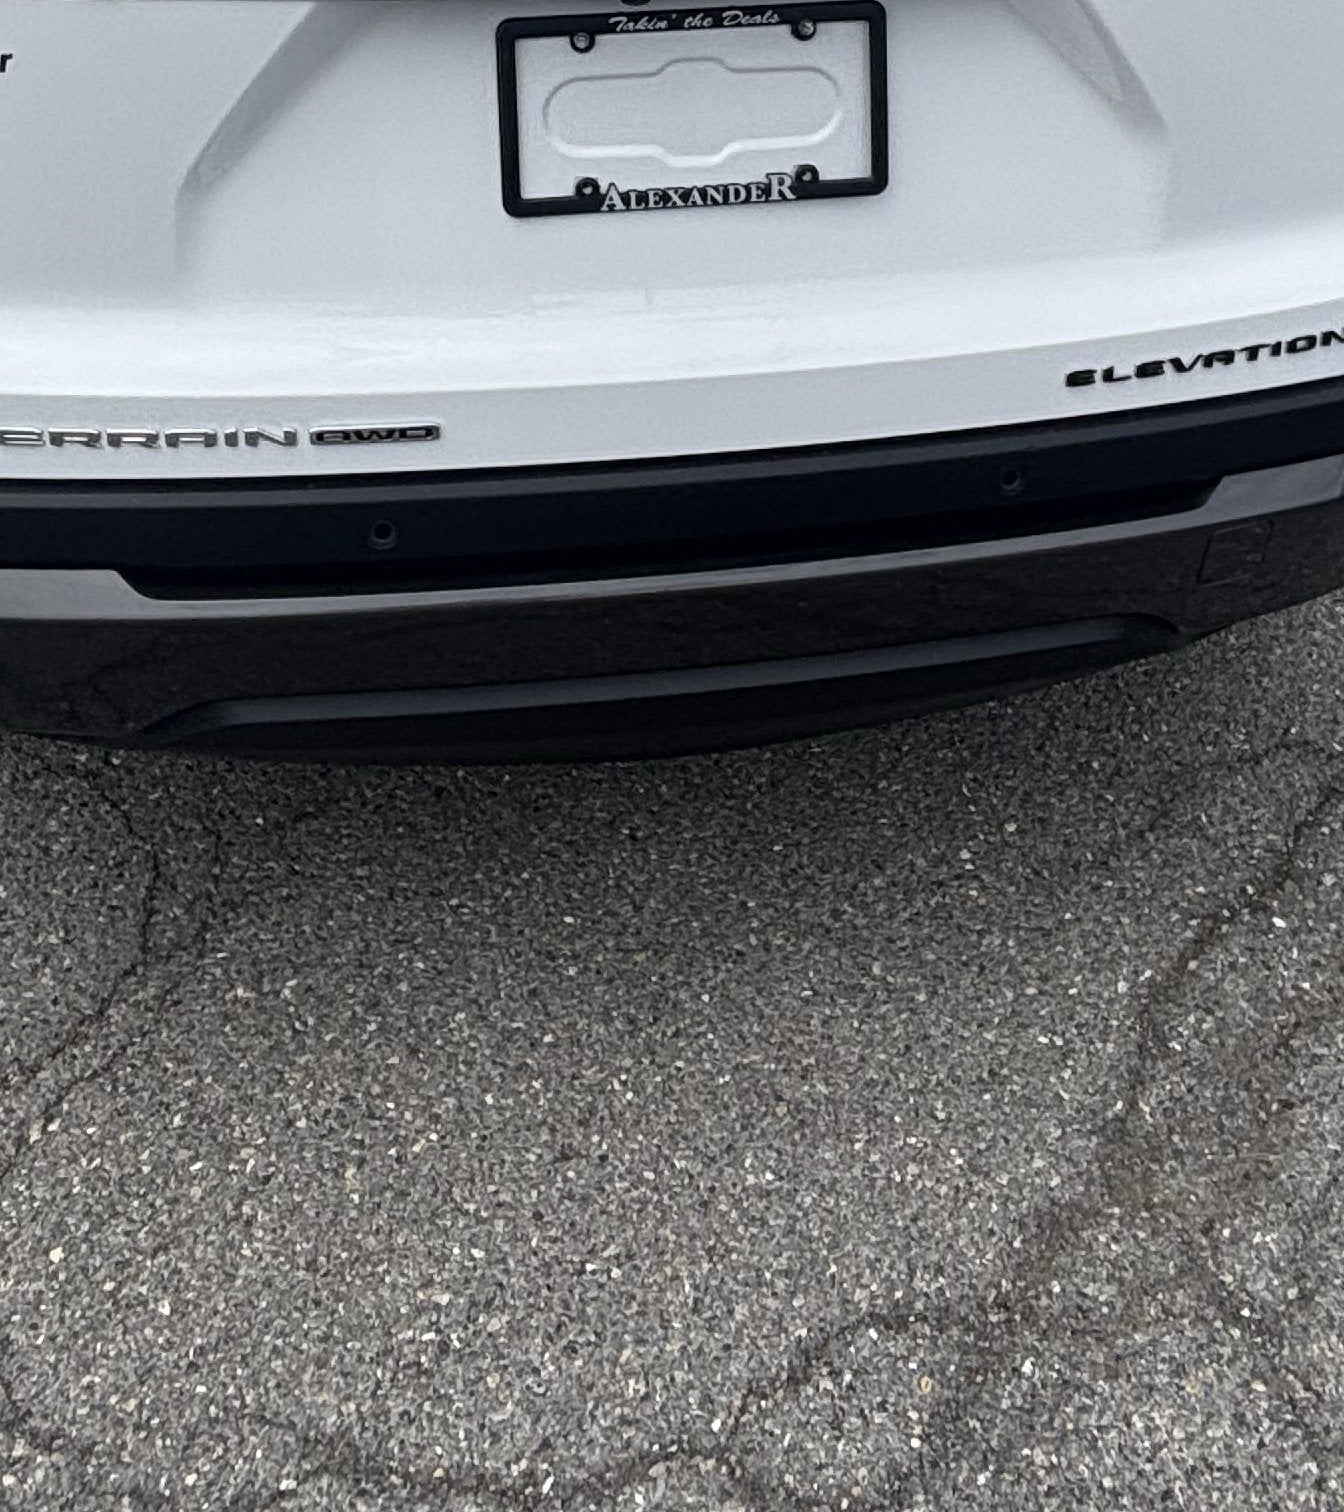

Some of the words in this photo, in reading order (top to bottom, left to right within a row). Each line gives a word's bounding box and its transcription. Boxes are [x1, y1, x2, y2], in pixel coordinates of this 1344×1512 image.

[683, 13, 713, 29] the
[721, 9, 781, 27] Deals
[313, 424, 437, 445] AWD
